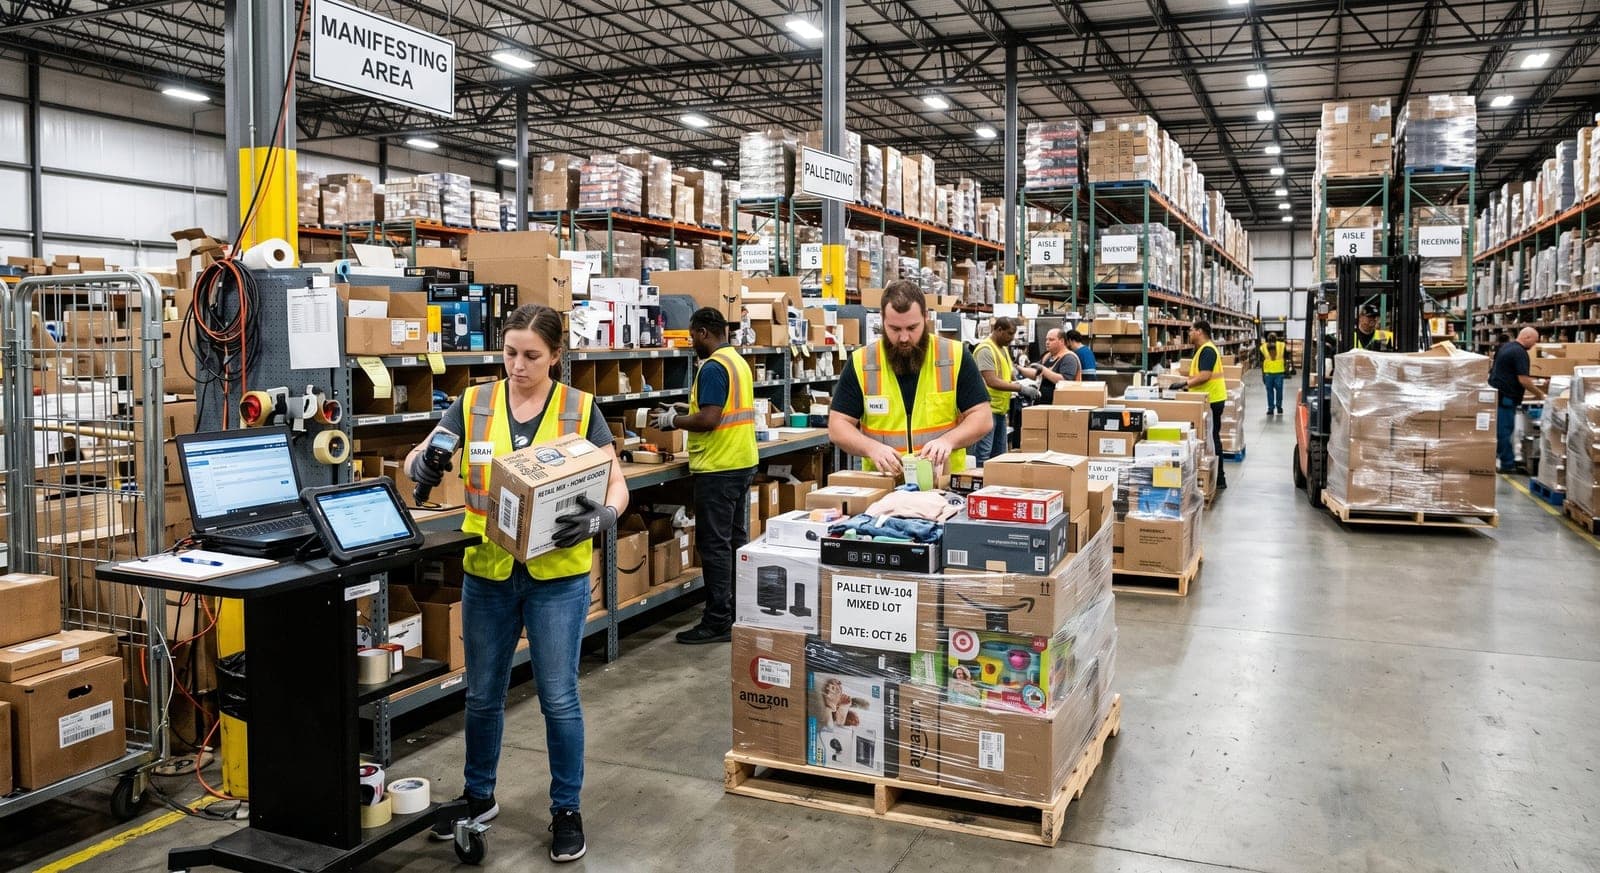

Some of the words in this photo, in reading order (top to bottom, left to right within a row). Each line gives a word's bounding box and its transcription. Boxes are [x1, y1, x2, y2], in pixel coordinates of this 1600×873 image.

[321, 14, 448, 73] MANIFESTING
[361, 57, 414, 90] AREA
[805, 162, 853, 186] PALLETIZING
[1037, 240, 1057, 248] AISLE
[1103, 245, 1136, 253] INVENTORY
[1349, 243, 1357, 254] 8
[811, 255, 817, 265] 5
[470, 448, 492, 456] SARAH
[537, 487, 555, 498] RETAIL
[556, 483, 566, 492] MIX
[570, 475, 587, 487] HOME
[587, 469, 606, 481] GOODS
[836, 581, 872, 594] PALLET
[874, 585, 912, 598] LW-104
[846, 598, 880, 611] MIXED
[882, 602, 902, 613] LOT
[839, 625, 869, 638] DATE:
[871, 629, 892, 641] OCT
[894, 632, 907, 643] 26
[739, 690, 789, 708] amazon
